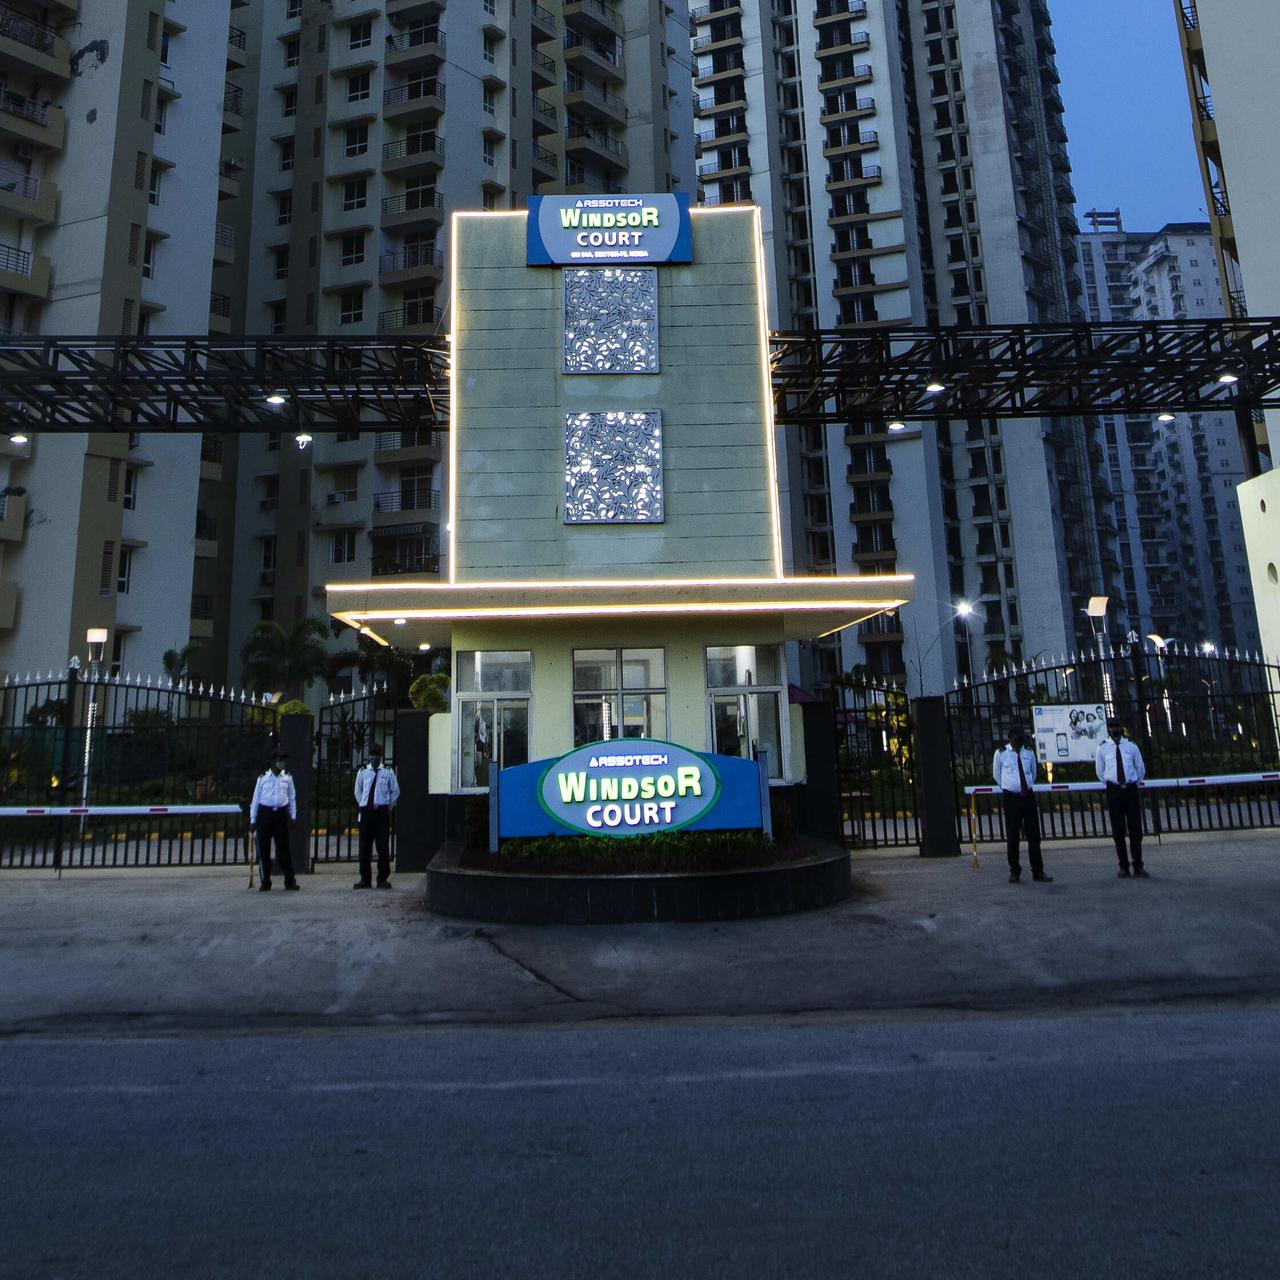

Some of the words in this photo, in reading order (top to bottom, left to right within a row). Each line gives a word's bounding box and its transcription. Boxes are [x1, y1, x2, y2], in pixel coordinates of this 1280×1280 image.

[584, 199, 643, 208] ASSOTECH
[560, 207, 659, 229] WINDSOR
[576, 232, 643, 247] COURT
[599, 754, 669, 767] ASSOTECH
[558, 766, 702, 803] WINDSOR
[586, 801, 677, 827] COURT
